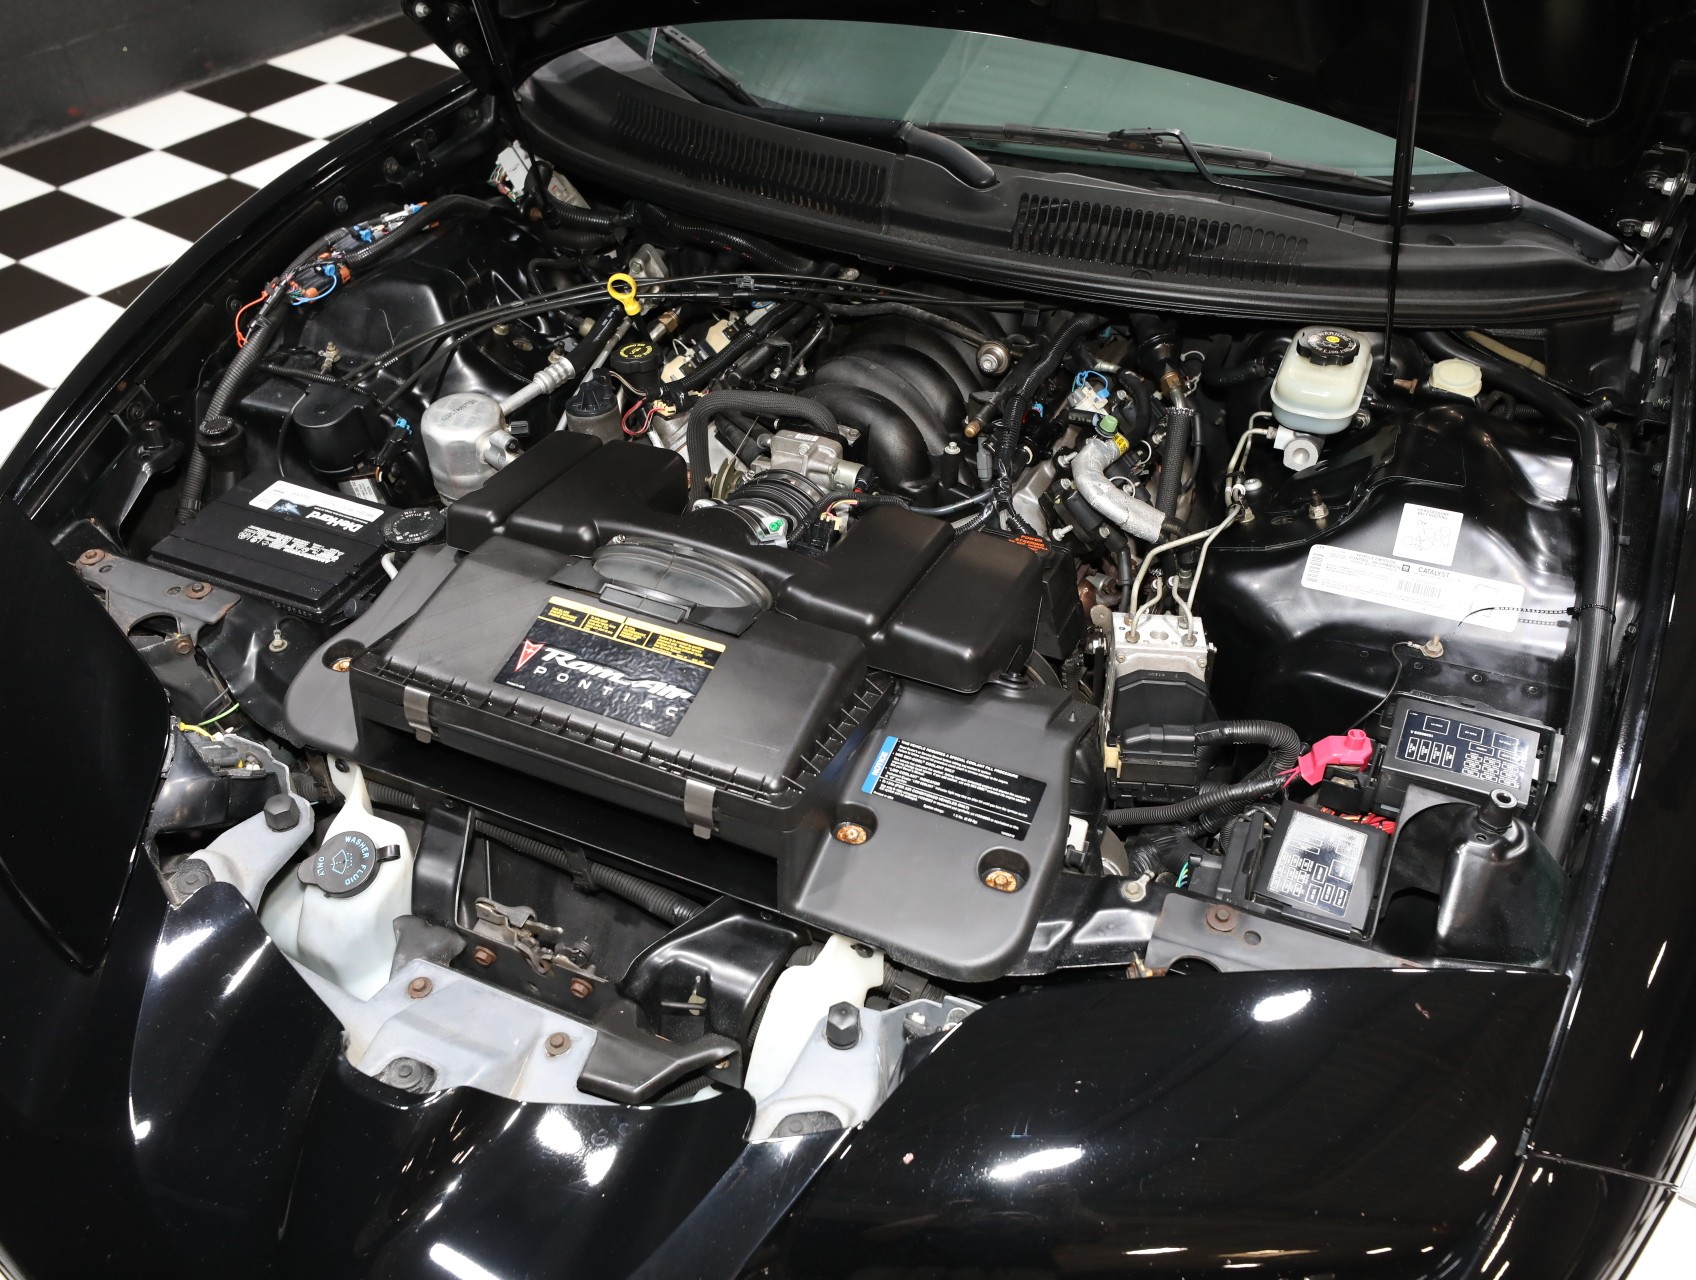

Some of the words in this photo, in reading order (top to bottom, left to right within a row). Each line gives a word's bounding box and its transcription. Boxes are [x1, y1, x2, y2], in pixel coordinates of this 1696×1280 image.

[1417, 566, 1450, 578] CATALYST
[542, 647, 632, 685] Ram
[533, 665, 680, 718] PONTIAC
[871, 752, 889, 776] NOTICE
[345, 835, 370, 859] WASHER
[316, 856, 326, 877] ONLY
[345, 864, 367, 886] FLUID
